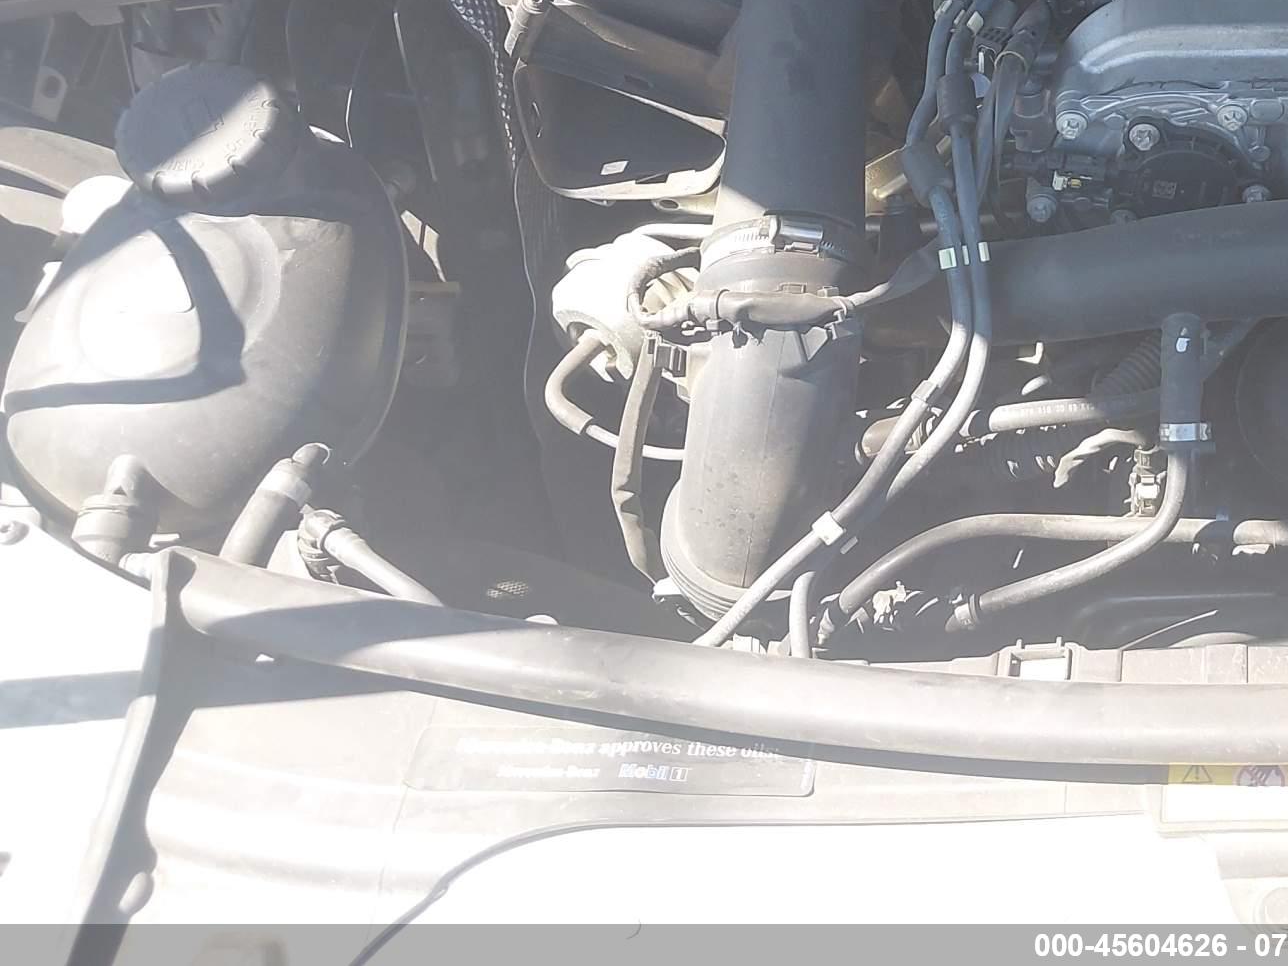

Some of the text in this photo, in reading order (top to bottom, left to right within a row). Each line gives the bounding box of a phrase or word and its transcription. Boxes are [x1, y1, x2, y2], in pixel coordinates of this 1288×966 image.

[598, 739, 682, 757] approves
[687, 741, 736, 758] these
[618, 763, 669, 781] Mobil
